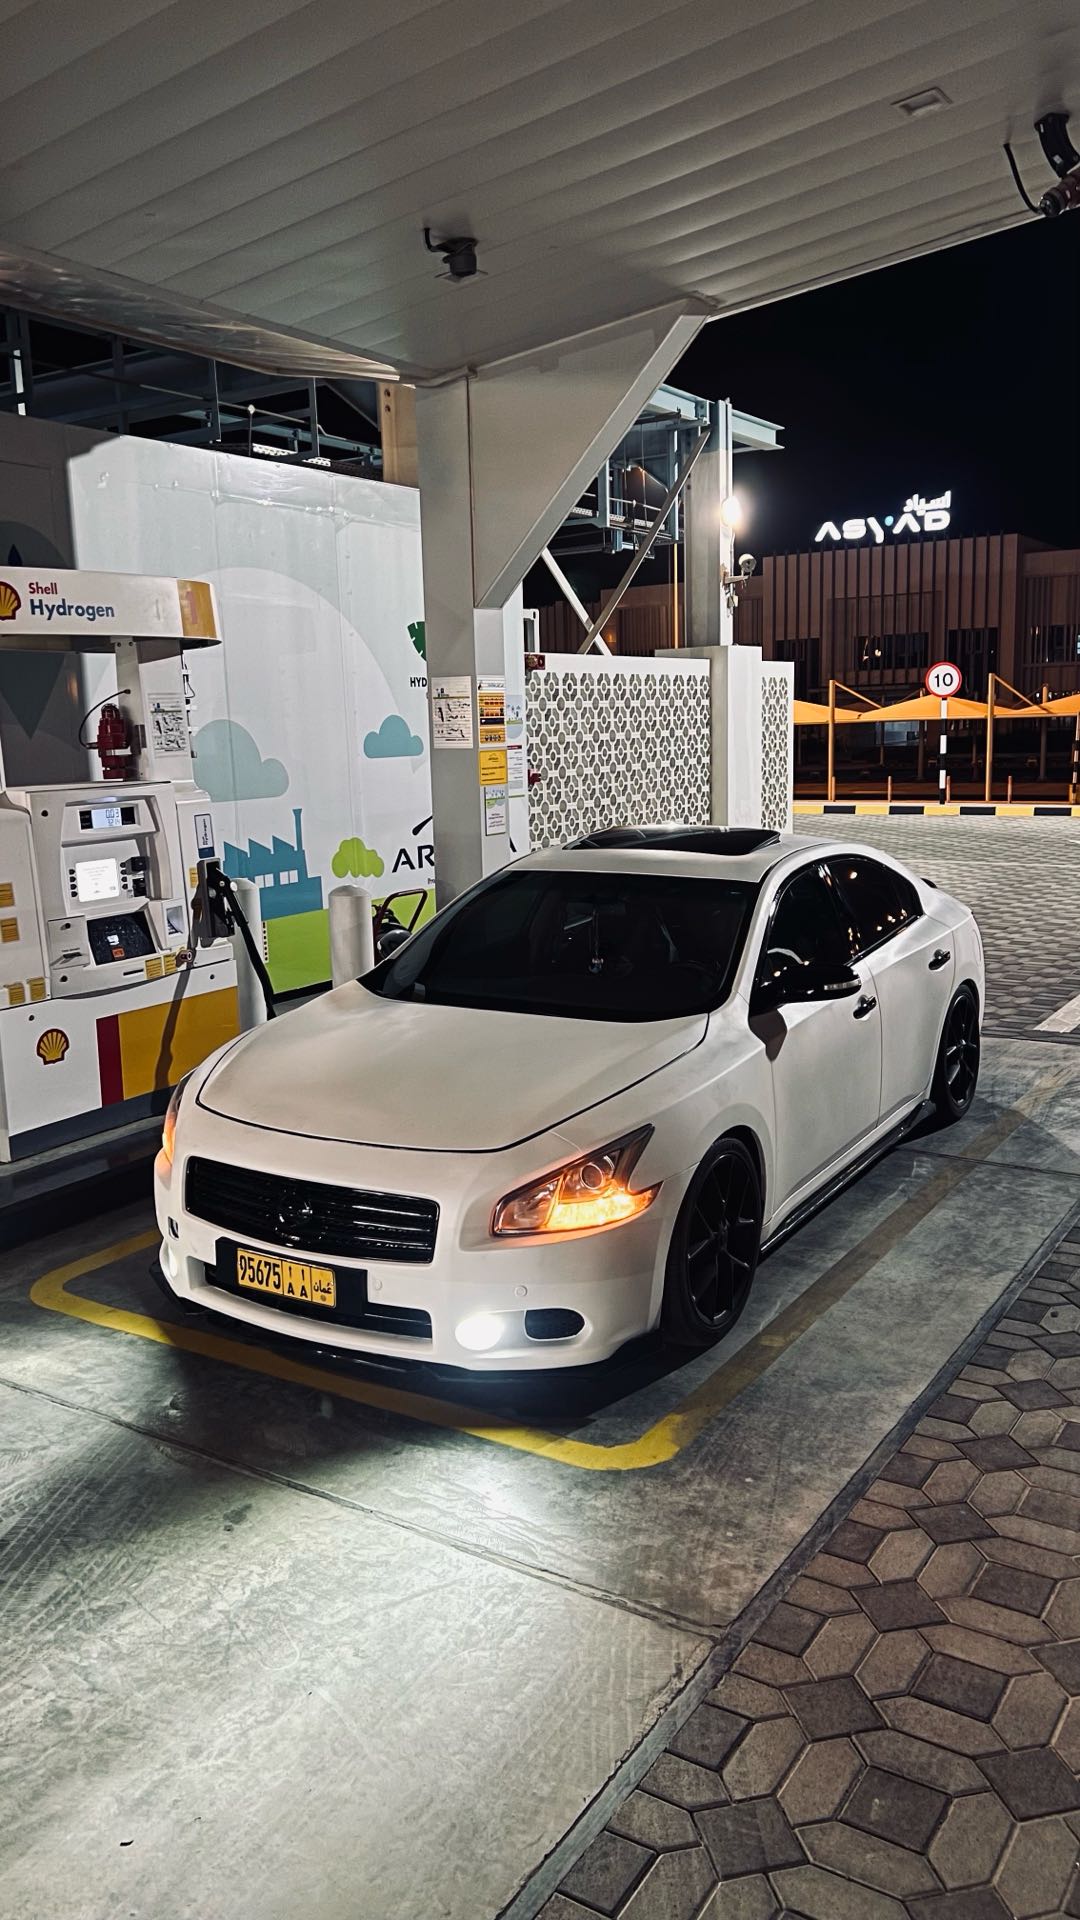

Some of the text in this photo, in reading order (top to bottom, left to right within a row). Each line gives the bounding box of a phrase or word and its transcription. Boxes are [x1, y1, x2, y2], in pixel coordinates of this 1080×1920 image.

[815, 509, 951, 544] ASYAD
[28, 582, 58, 595] Shell
[30, 598, 115, 622] Hydrogen
[410, 676, 428, 688] HYD
[934, 672, 954, 688] 10
[392, 844, 435, 873] AR
[239, 1254, 282, 1290] 95675
